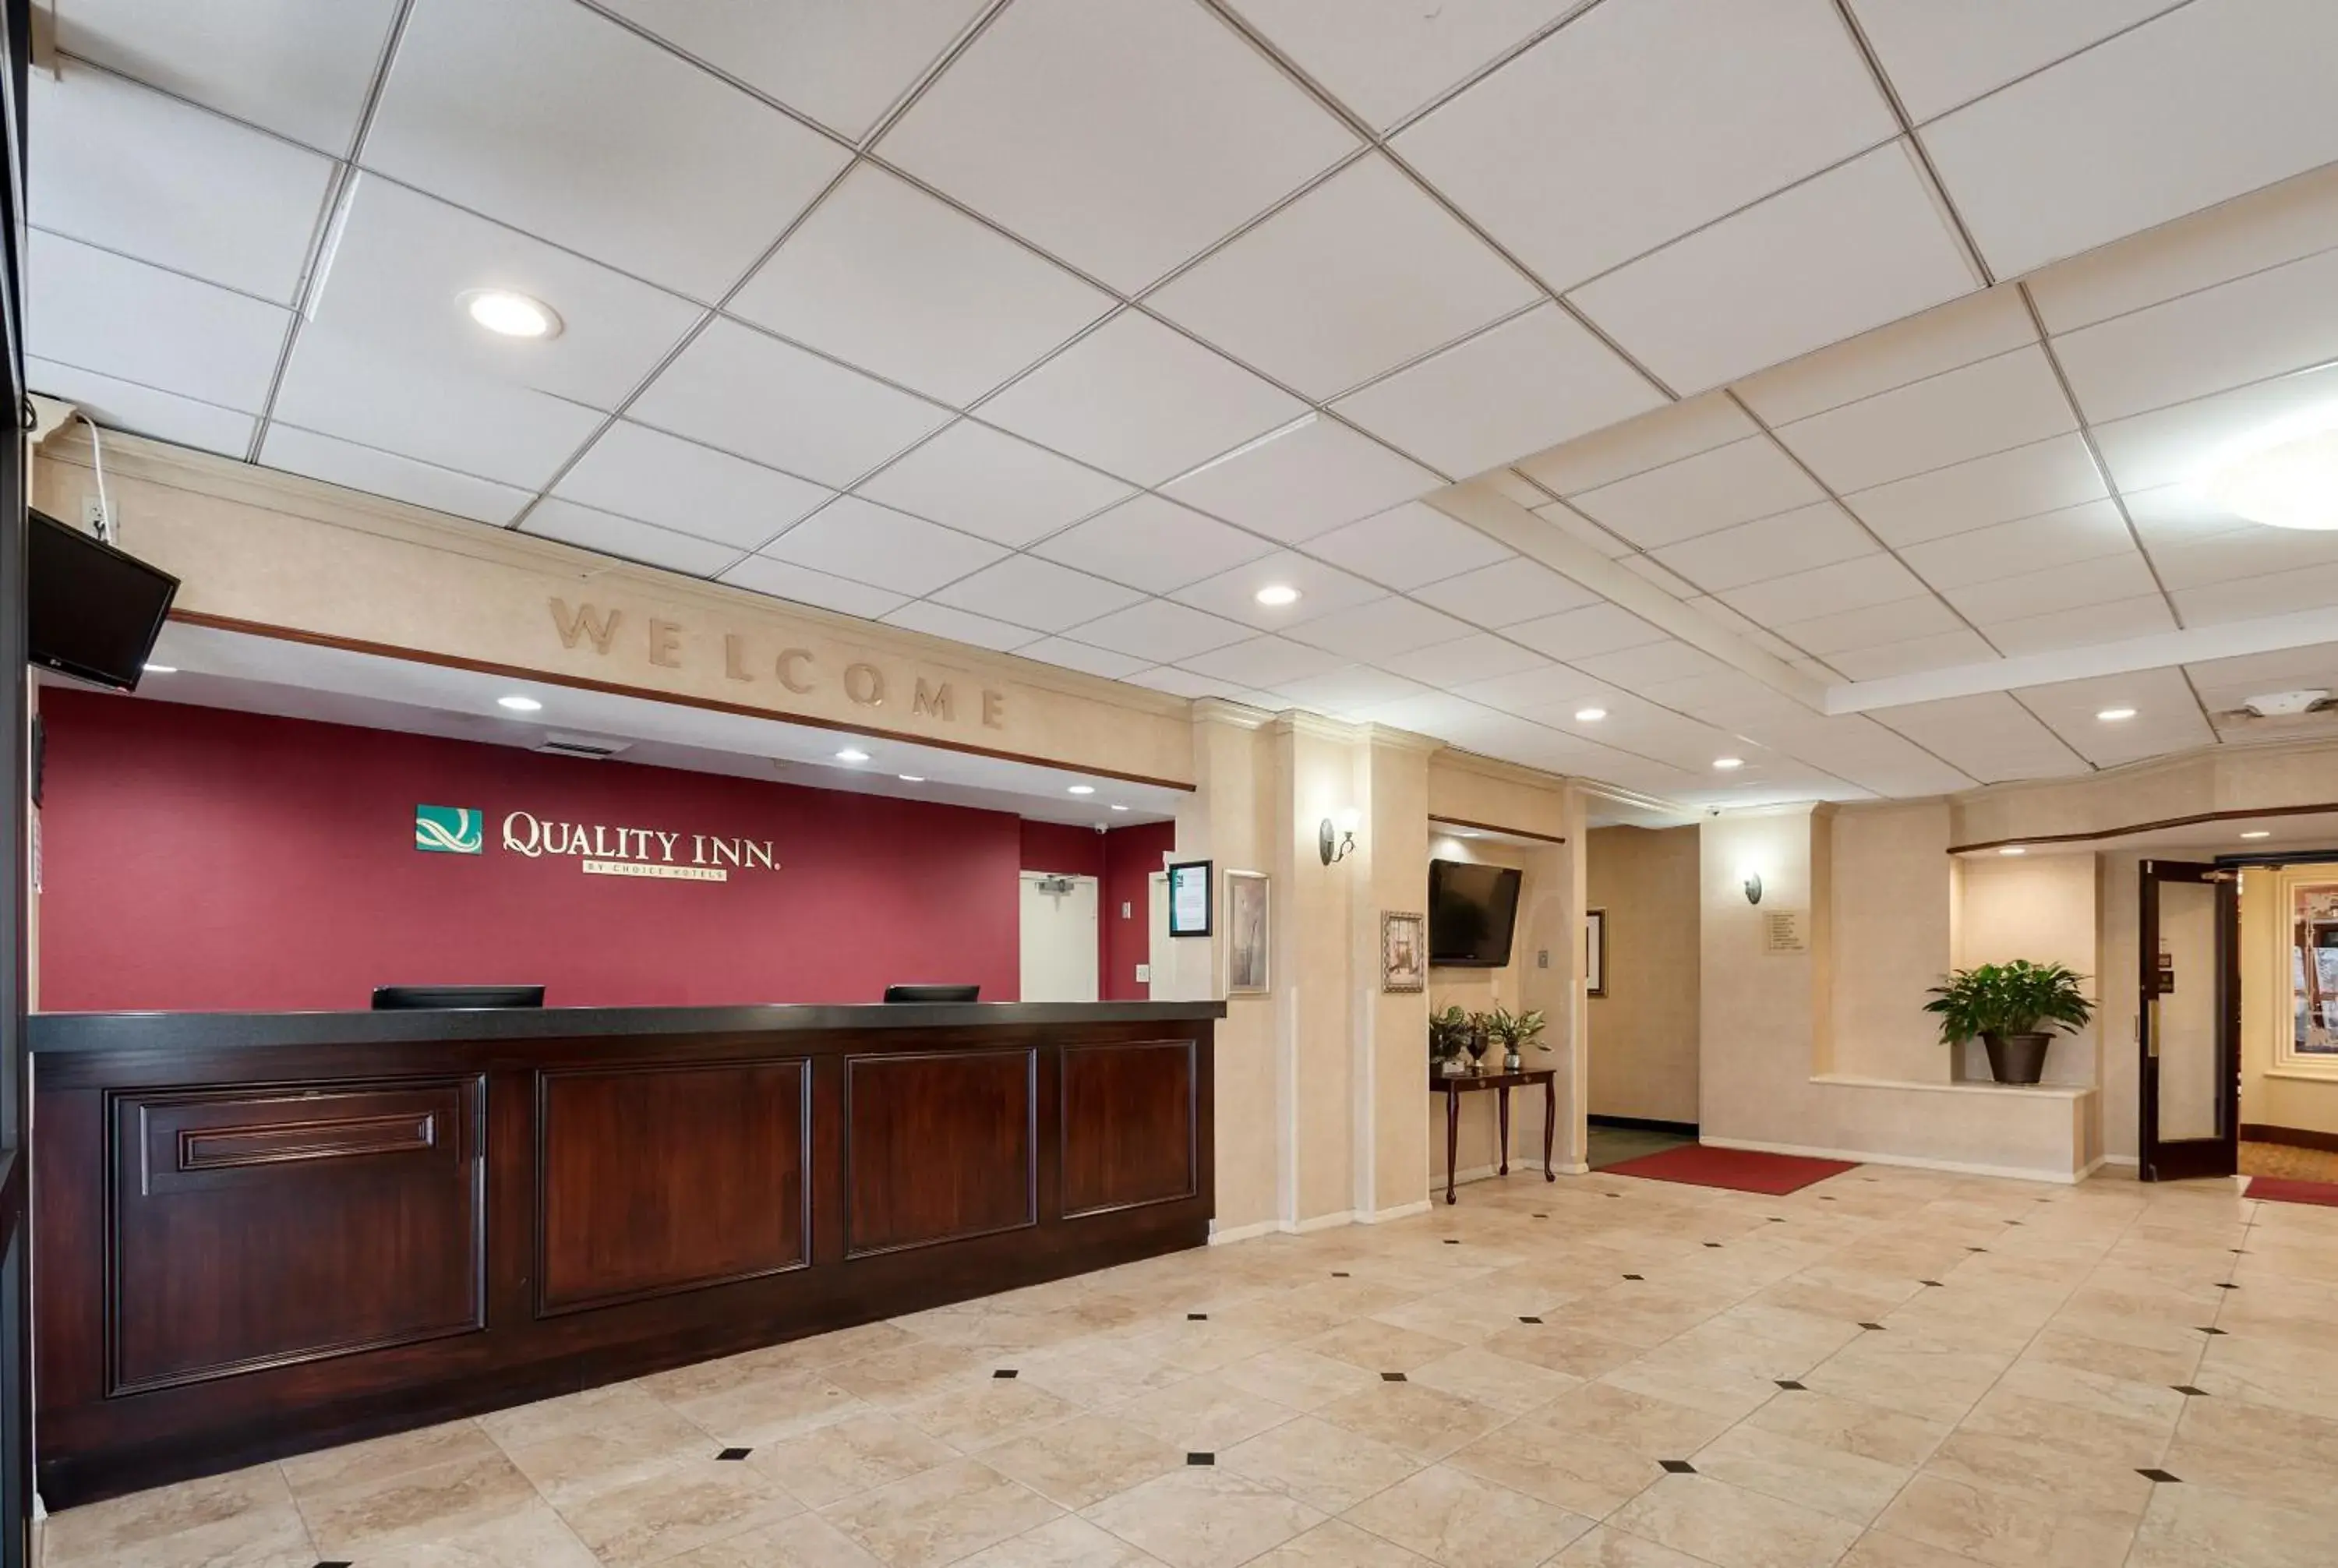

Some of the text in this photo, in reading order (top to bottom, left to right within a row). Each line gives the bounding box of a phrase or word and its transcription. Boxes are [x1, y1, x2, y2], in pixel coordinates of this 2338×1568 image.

[549, 598, 1005, 731] WELCOME
[503, 811, 680, 861] QUALITY
[588, 863, 723, 879] BY CHOICE HOTELS
